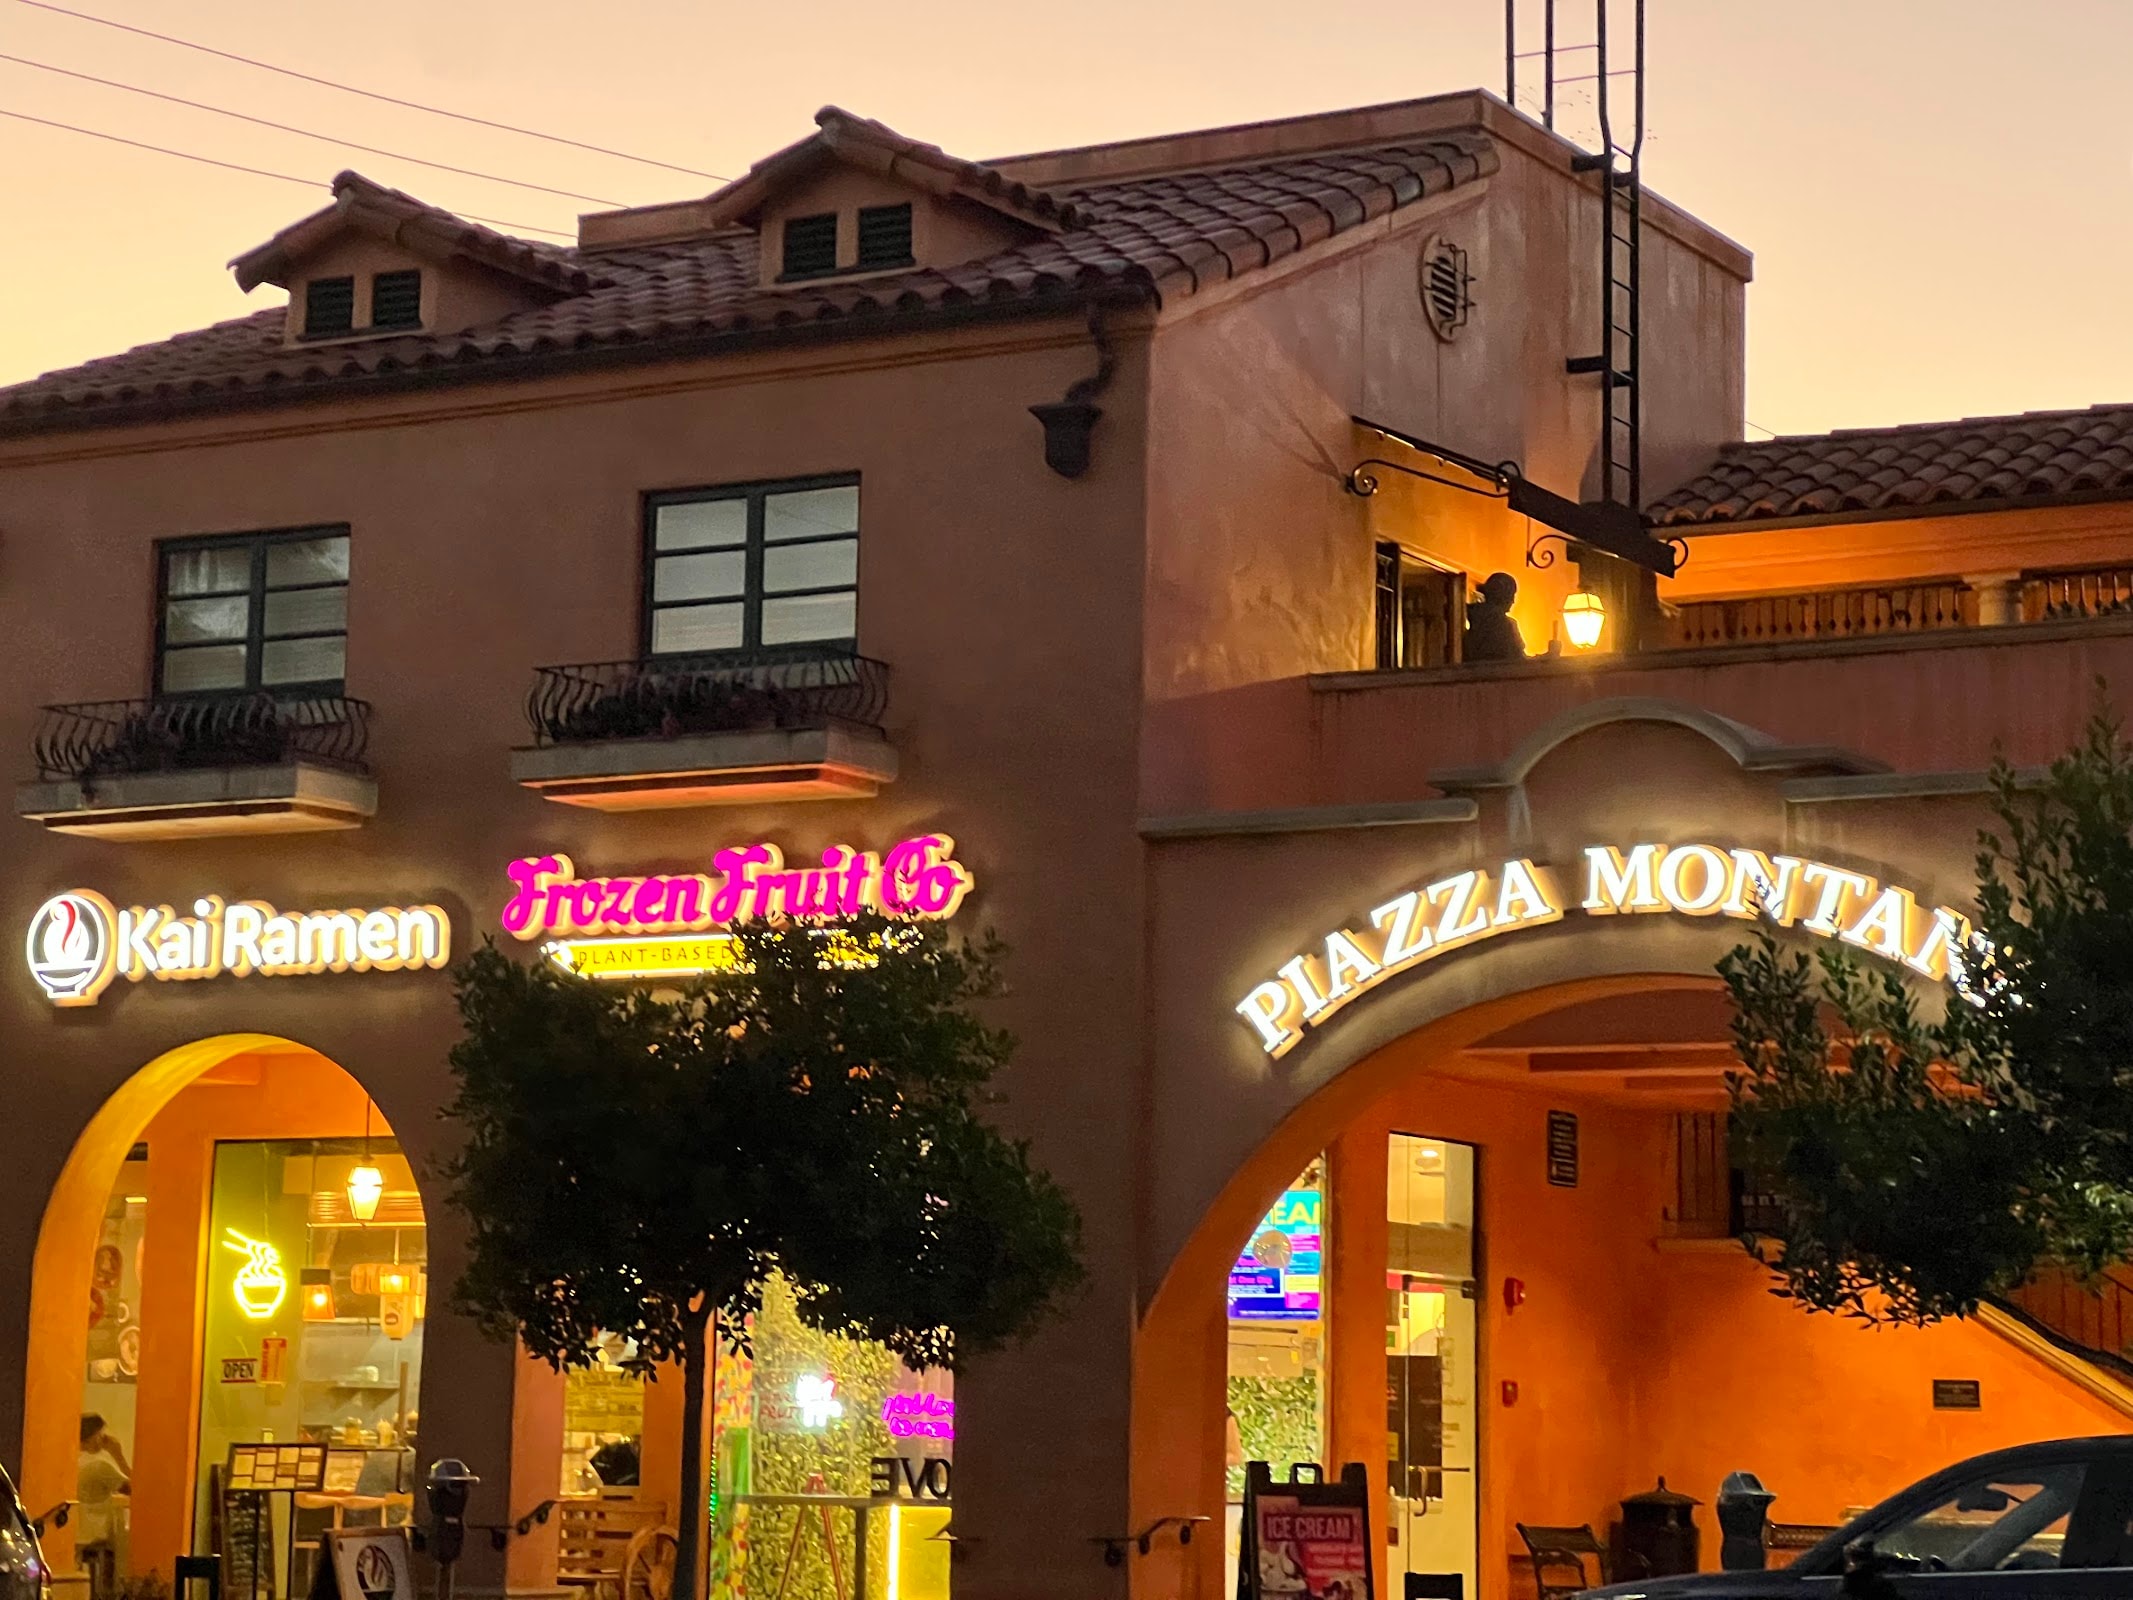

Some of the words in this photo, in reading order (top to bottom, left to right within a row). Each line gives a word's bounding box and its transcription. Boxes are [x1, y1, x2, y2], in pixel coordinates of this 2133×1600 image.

[502, 855, 706, 932] Frozen
[711, 845, 869, 923] Fruit
[881, 835, 966, 914] Co
[116, 898, 209, 973] Kai
[222, 903, 436, 967] Ramen
[1235, 860, 1553, 1054] PIAZZA
[1581, 844, 2024, 1010] MONTAN
[224, 1362, 255, 1379] OPEN
[1266, 1516, 1292, 1539] ICE
[1295, 1516, 1351, 1539] CREAM
